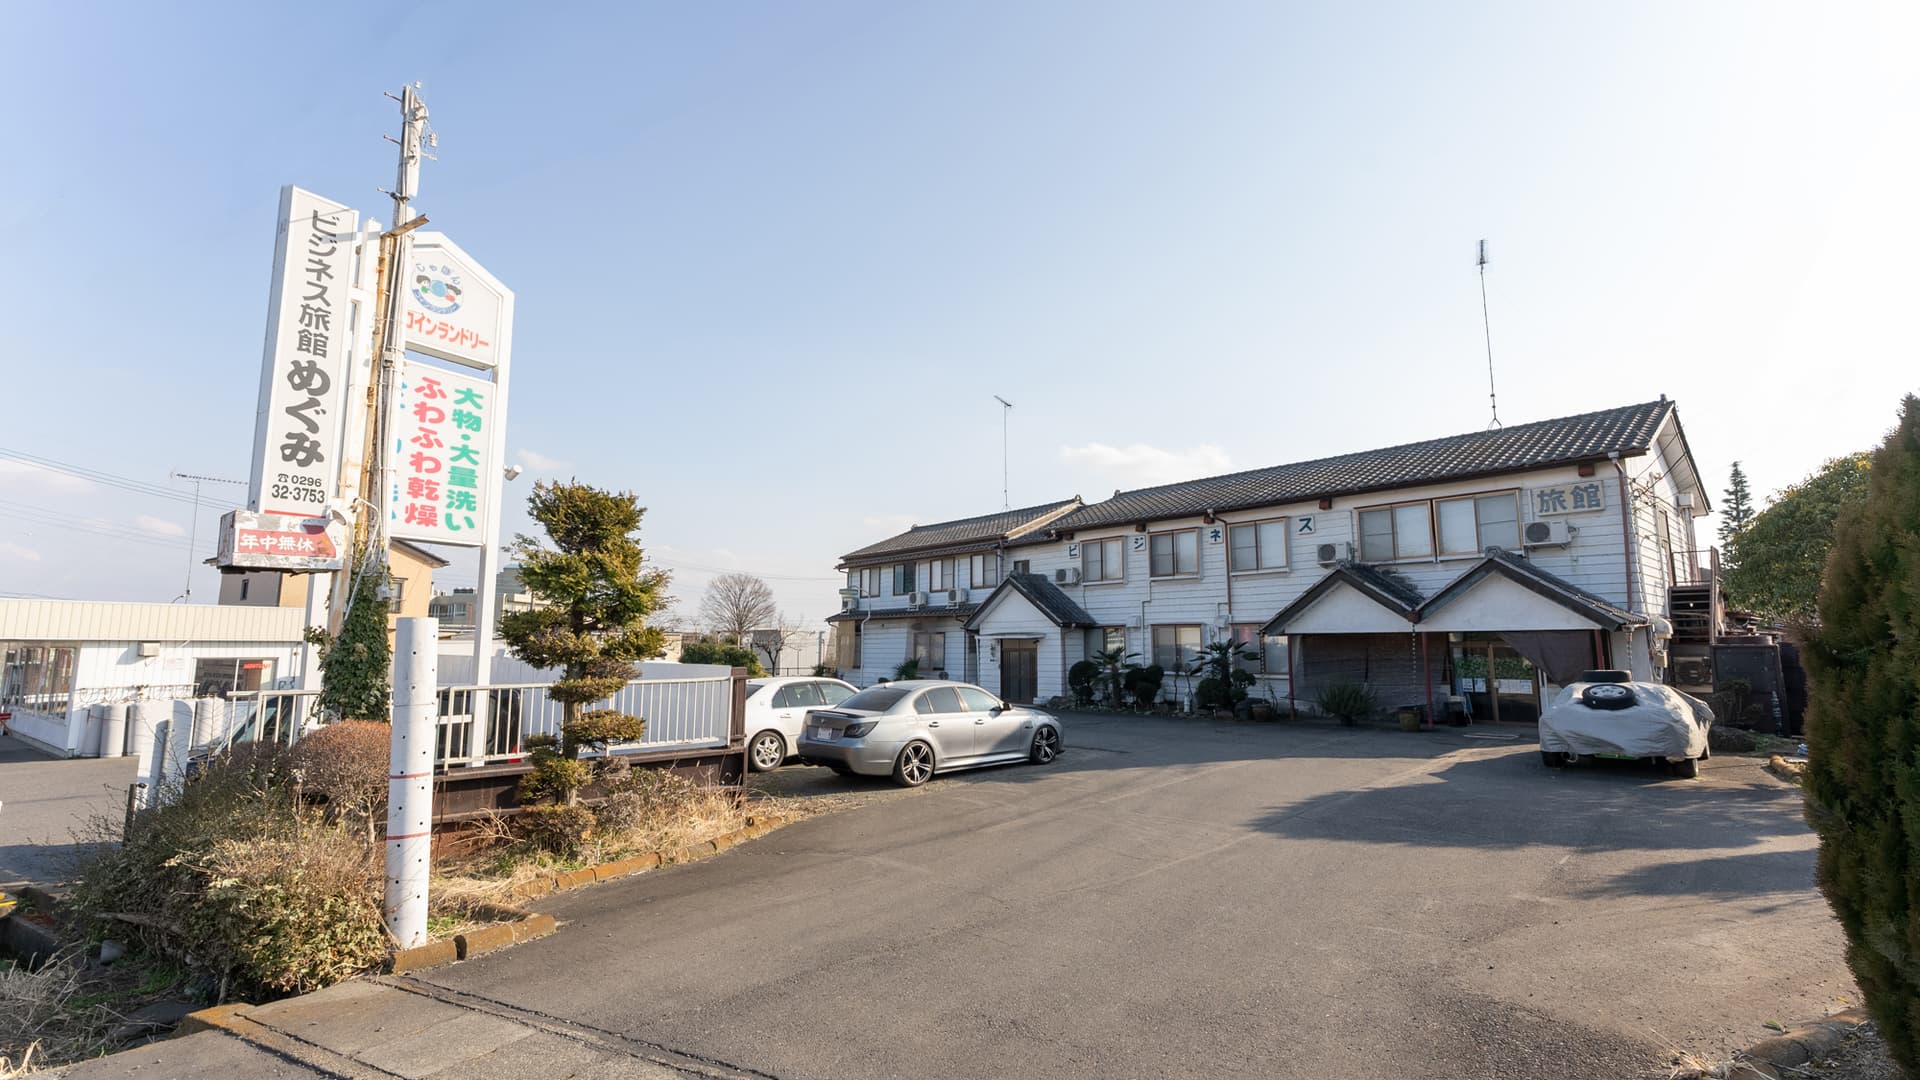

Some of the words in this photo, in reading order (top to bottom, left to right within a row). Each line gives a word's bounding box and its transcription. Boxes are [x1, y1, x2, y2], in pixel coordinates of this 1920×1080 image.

[404, 376, 447, 527] ふわふわ乾燥
[444, 387, 484, 531] 大物・大量洗い
[291, 475, 322, 487] 0296
[1537, 483, 1601, 513] 旅館
[240, 533, 315, 552] 年中無休
